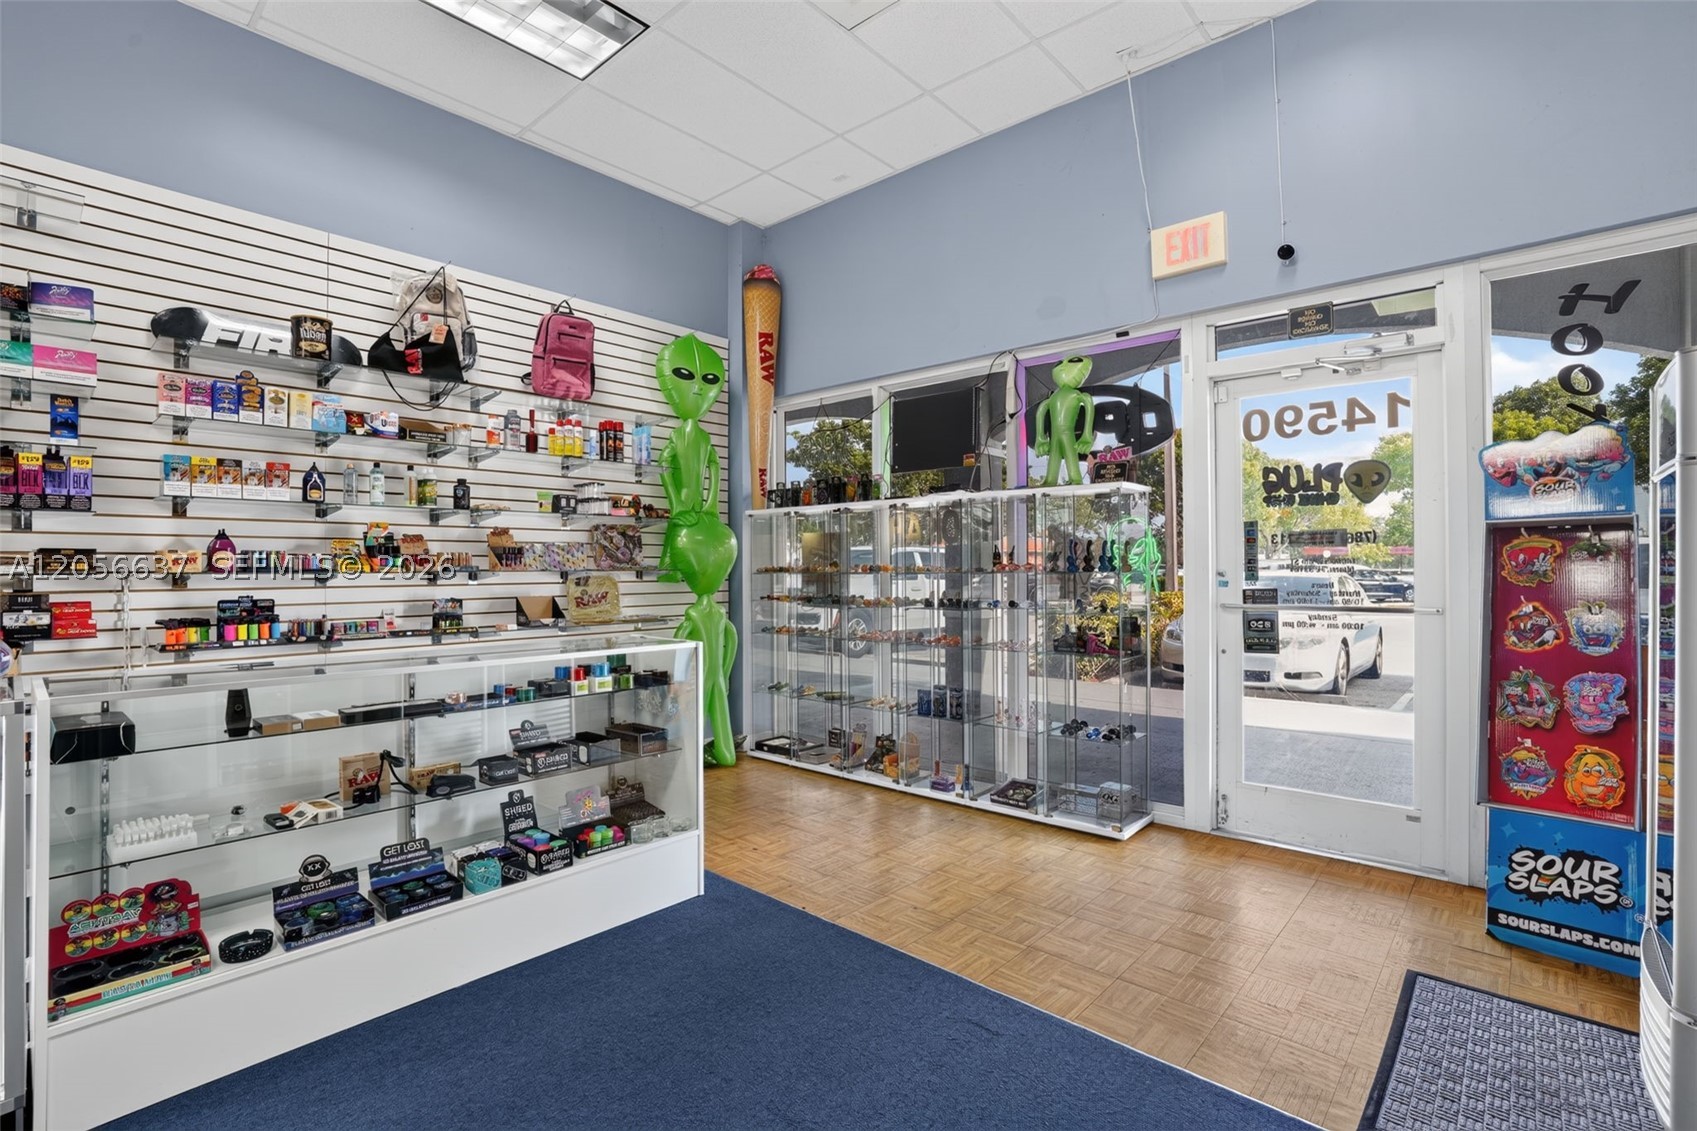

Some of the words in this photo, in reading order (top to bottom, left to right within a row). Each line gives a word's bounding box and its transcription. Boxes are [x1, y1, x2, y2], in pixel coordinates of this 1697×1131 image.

[1165, 222, 1211, 266] EXIT
[758, 331, 774, 386] RAW
[1098, 447, 1131, 462] RAW
[347, 771, 380, 788] RAW
[383, 845, 403, 857] GET
[403, 840, 425, 852] LOST
[1510, 850, 1621, 885] SOUR
[1508, 871, 1618, 905] SLAPS
[1497, 913, 1641, 958] SOURSLAPS.COM
